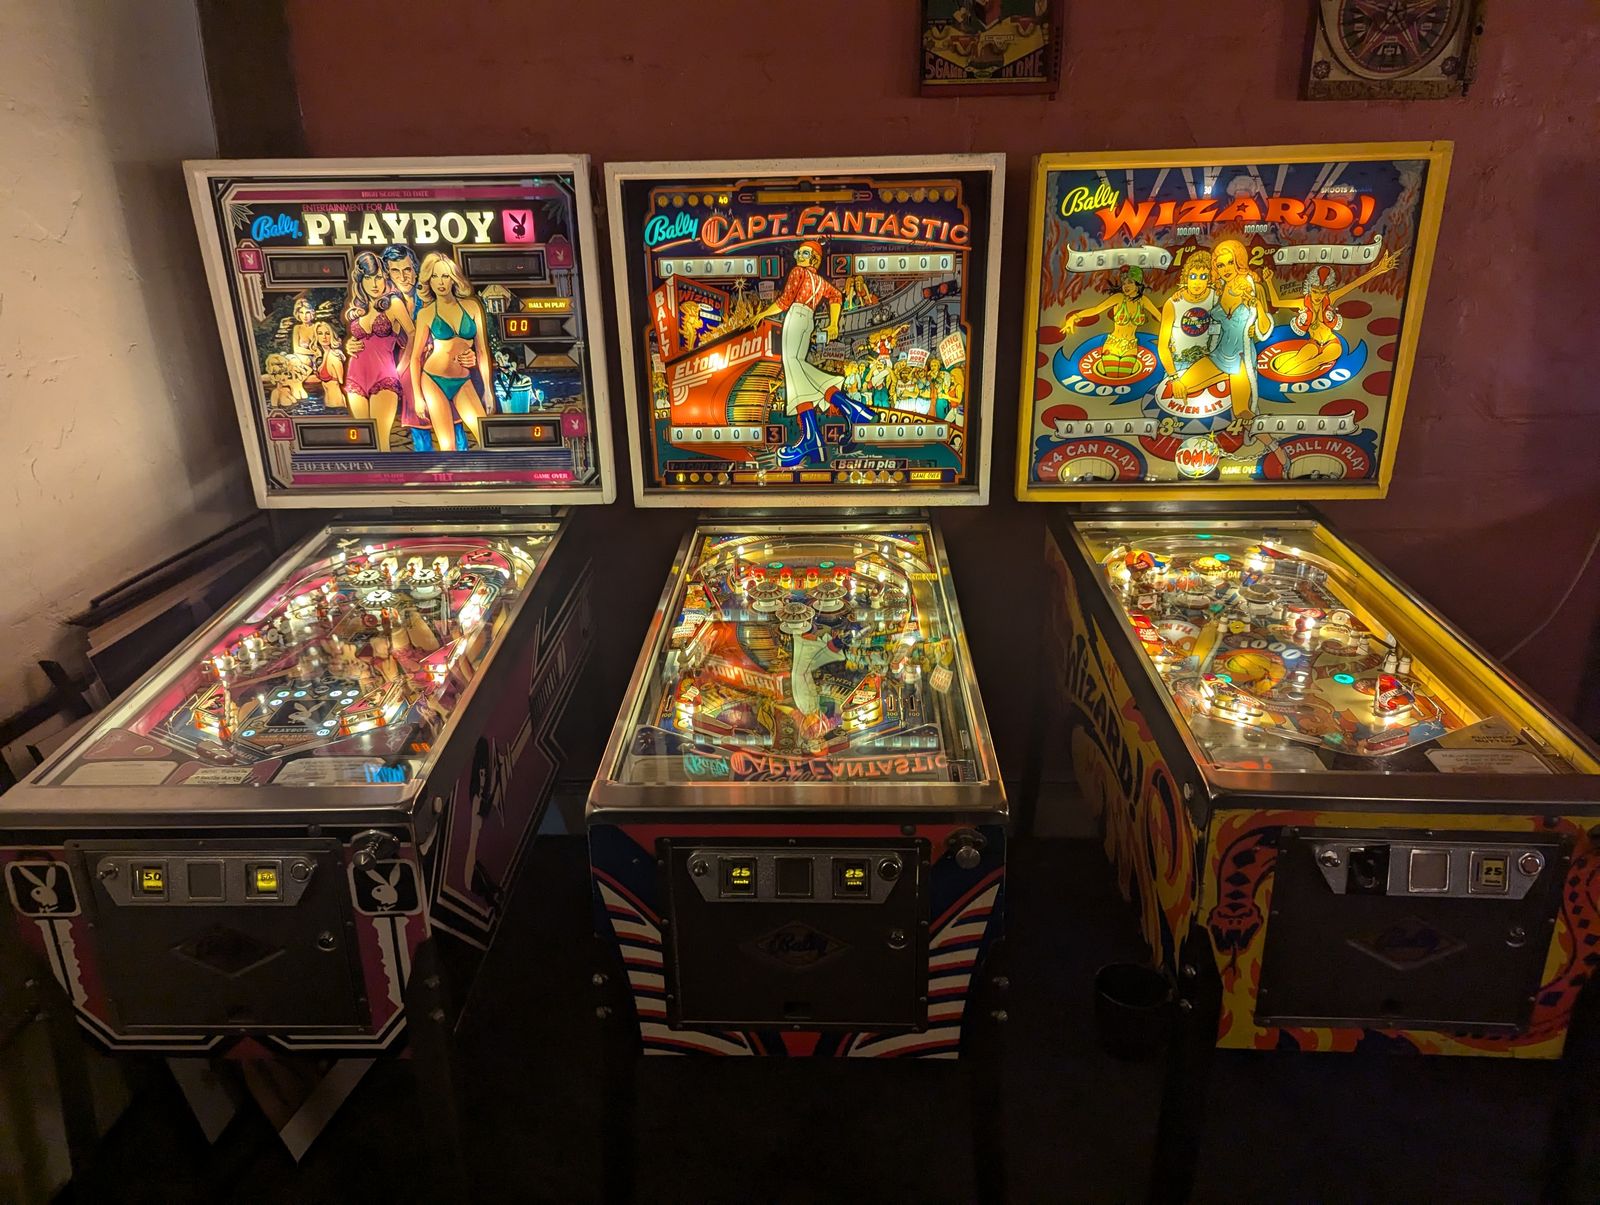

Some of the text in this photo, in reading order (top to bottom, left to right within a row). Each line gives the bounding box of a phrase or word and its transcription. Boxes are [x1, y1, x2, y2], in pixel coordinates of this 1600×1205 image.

[302, 203, 400, 212] ENTERTAINMENT FOR ALL
[718, 196, 729, 204] 40
[1061, 183, 1120, 217] Bally
[1095, 195, 1376, 241] WIZARD!
[251, 213, 300, 242] Bally
[303, 211, 494, 245] PLAYBOY
[644, 211, 699, 246] Bally
[701, 207, 969, 248] CAPT. FANTASTIC
[765, 258, 771, 275] 1
[835, 258, 847, 273] 2
[654, 291, 670, 357] BALLY
[940, 335, 959, 352] RING
[942, 343, 962, 358] THEM
[822, 351, 844, 360] CHAMP
[909, 349, 928, 357] SCORE
[944, 350, 964, 366] BELLS
[1136, 349, 1153, 373] LOVE
[1257, 347, 1282, 370] EVIL
[1080, 350, 1102, 375] LOVE
[1062, 374, 1131, 396] 1000
[1279, 368, 1351, 393] 1000
[1167, 400, 1224, 414] WHEN LIT
[768, 427, 780, 441] 3
[827, 428, 839, 440] 4
[838, 459, 861, 469] Ball
[863, 459, 875, 469] in
[1066, 443, 1098, 456] CAN
[1103, 445, 1136, 472] PLAY
[1176, 449, 1217, 467] TOMMY
[1284, 440, 1365, 472] BALL IN PLAY
[1221, 463, 1262, 474] GAME OVER
[144, 872, 161, 881] 50
[732, 867, 750, 877] 25
[845, 868, 864, 878] 25
[1484, 867, 1502, 876] 25
